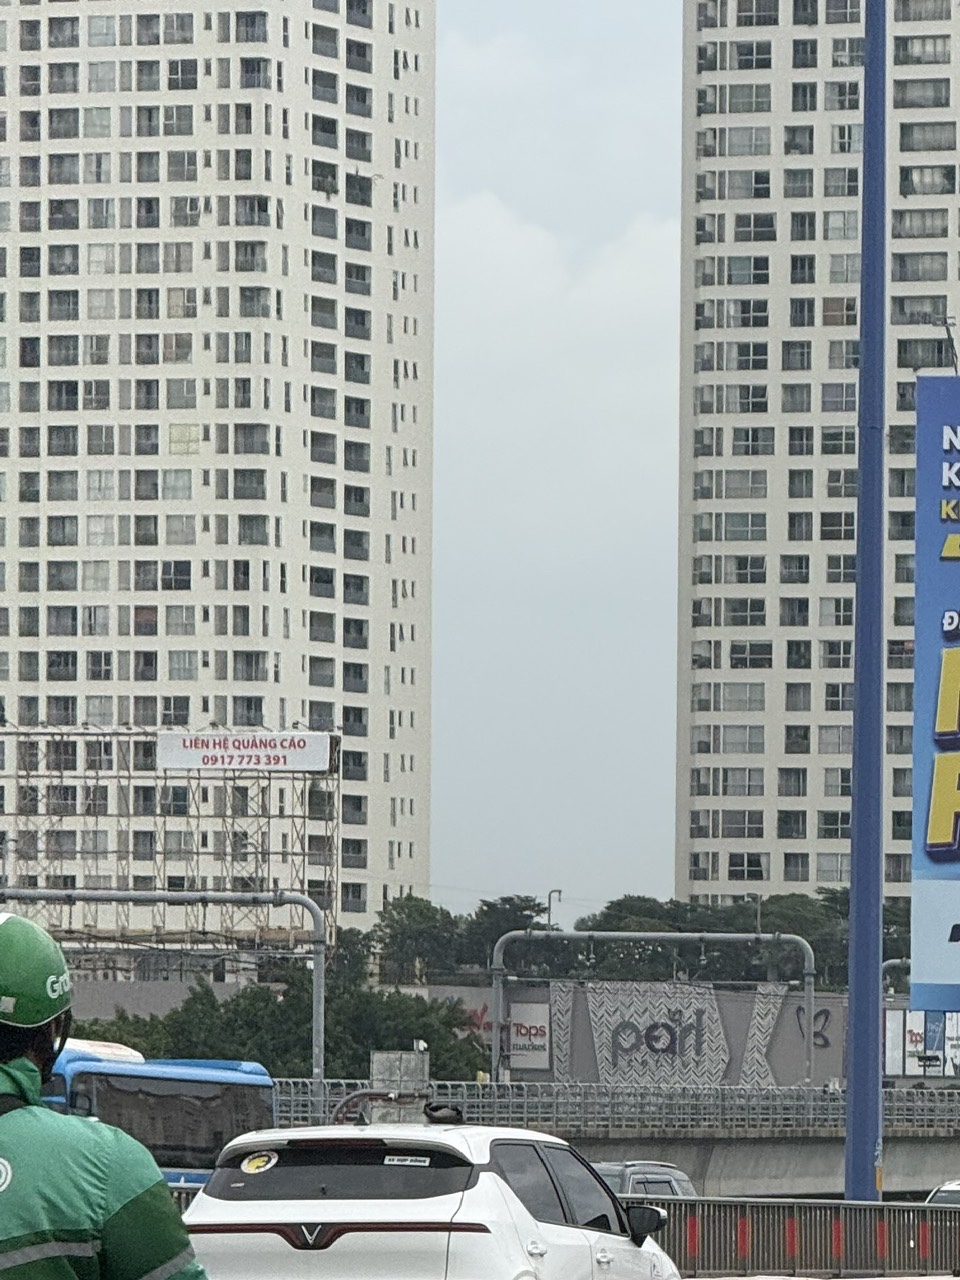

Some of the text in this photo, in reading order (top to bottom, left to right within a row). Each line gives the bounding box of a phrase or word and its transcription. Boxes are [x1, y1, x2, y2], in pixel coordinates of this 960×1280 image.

[182, 735, 306, 752] LIÊN HỆ QUẢNG CÁO
[202, 755, 287, 765] 0917 773 391
[46, 973, 72, 998] Gra
[513, 1022, 547, 1041] Tops
